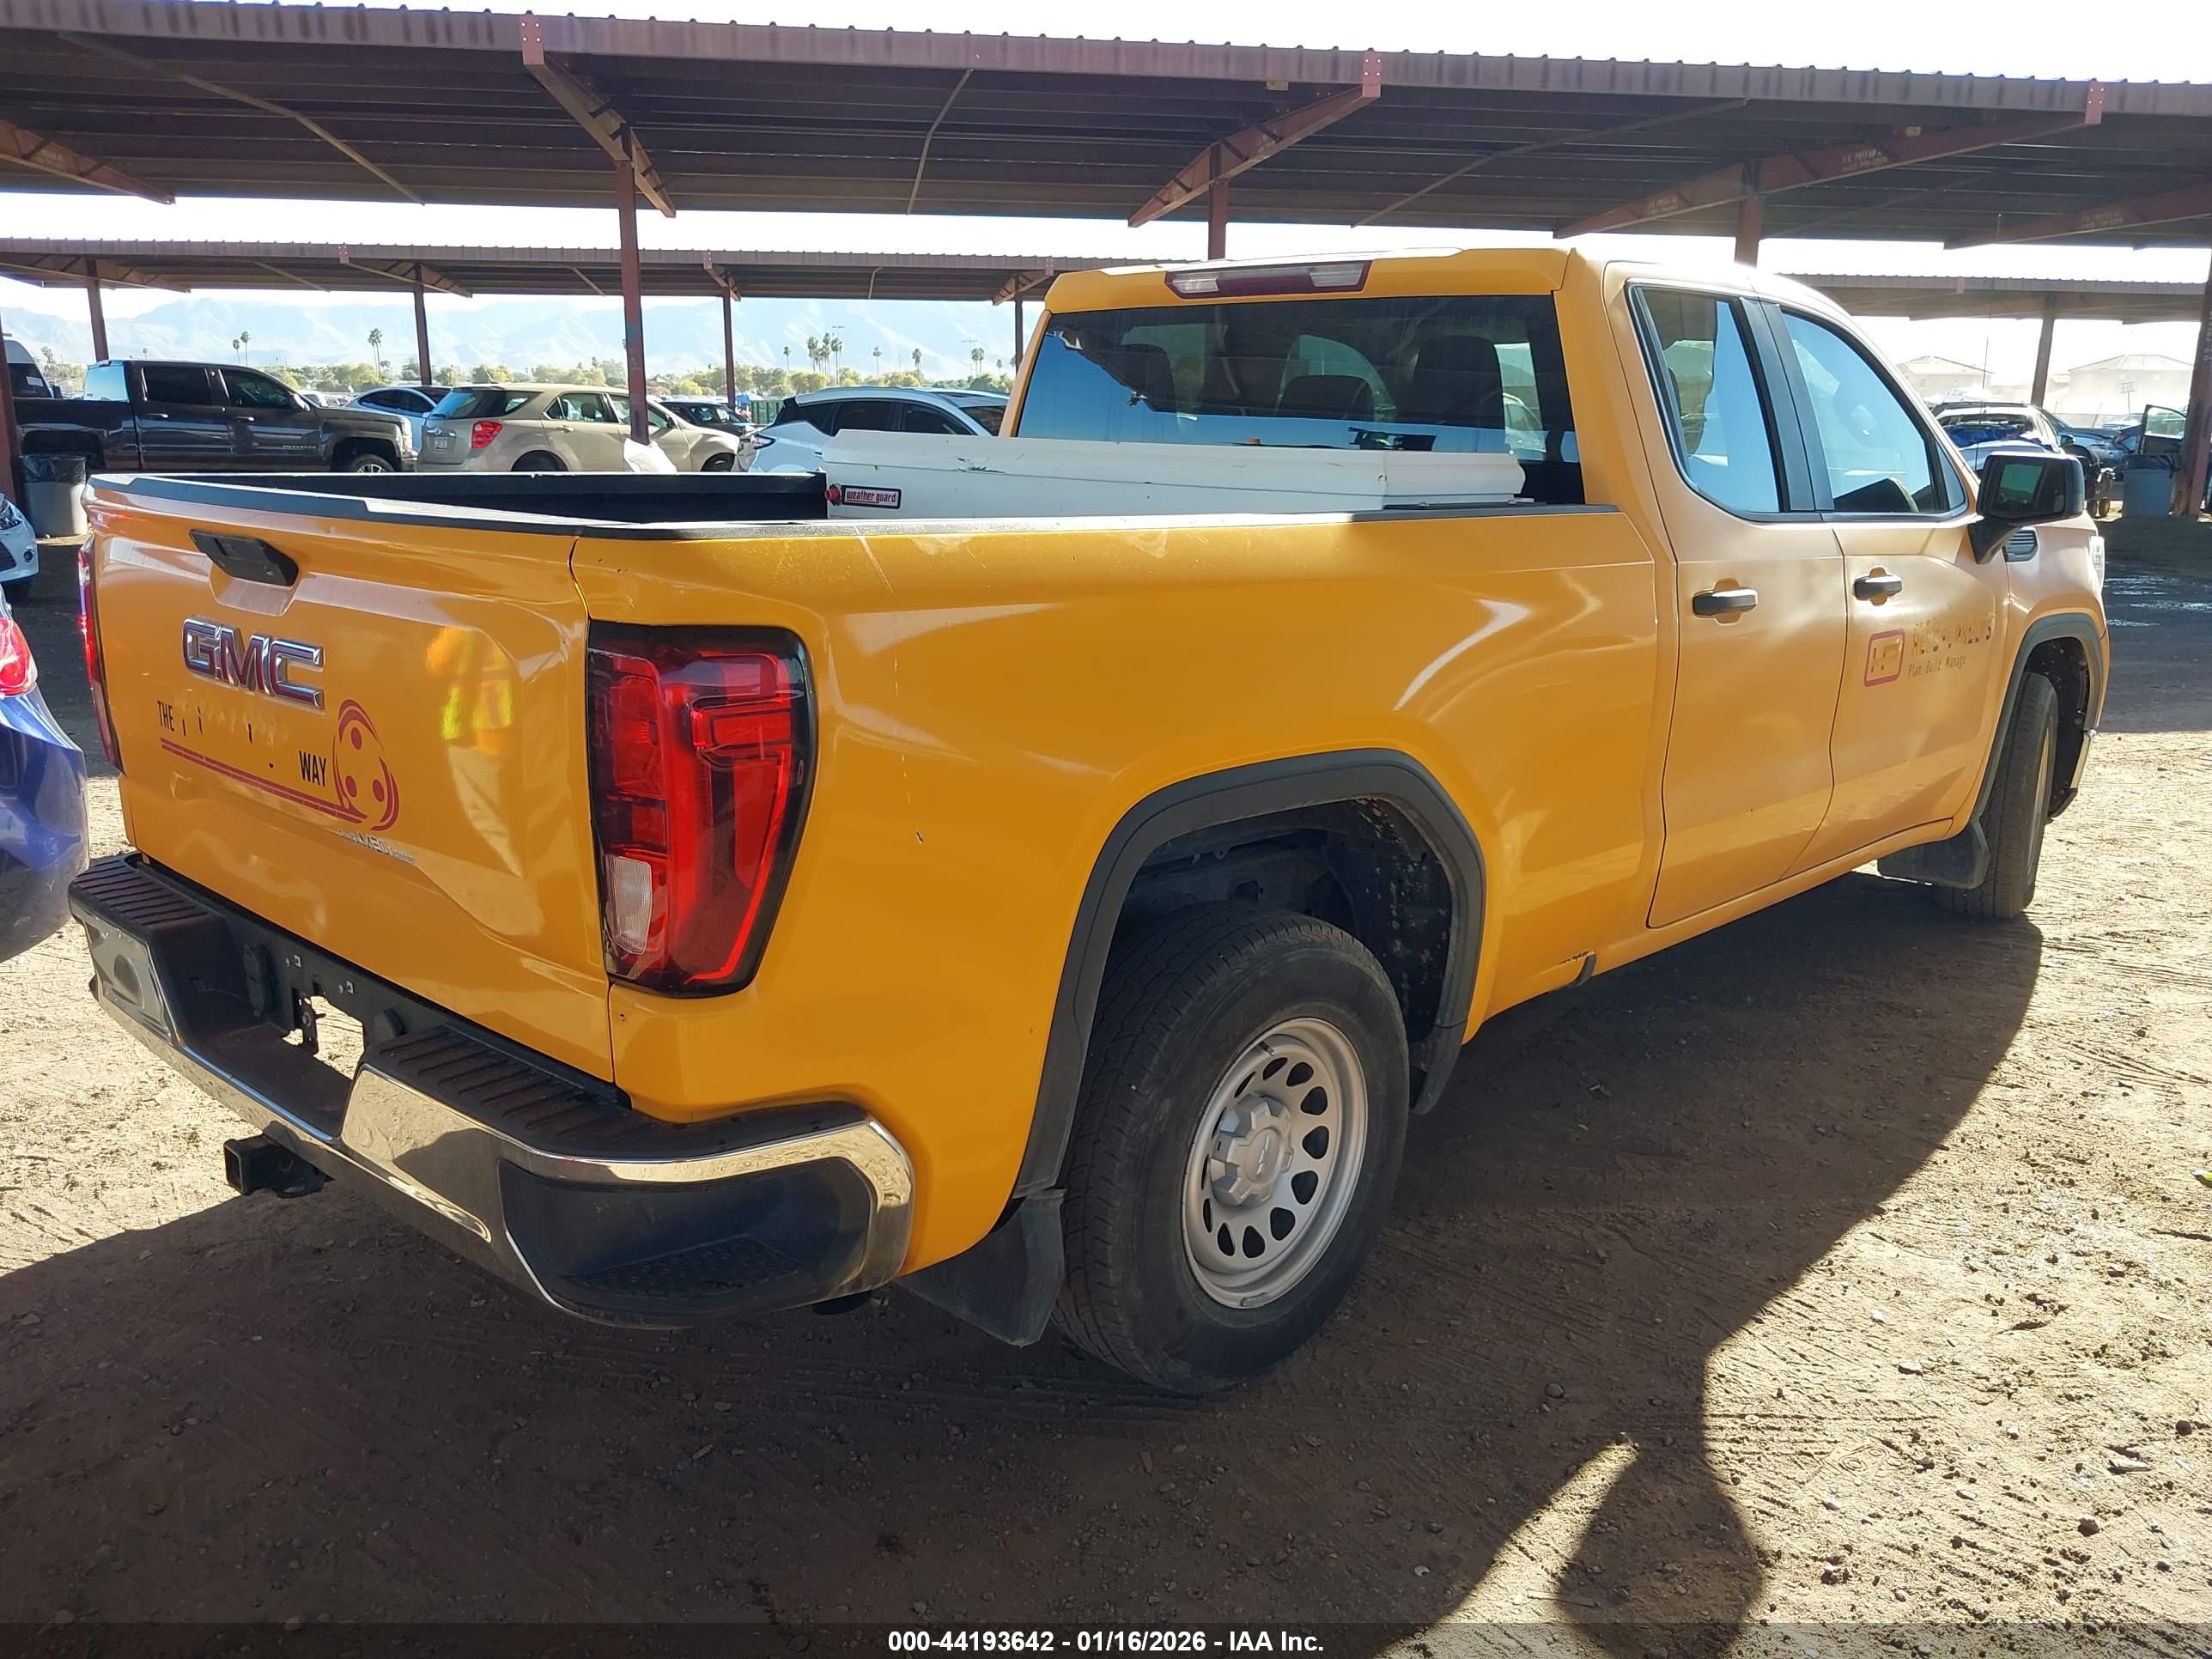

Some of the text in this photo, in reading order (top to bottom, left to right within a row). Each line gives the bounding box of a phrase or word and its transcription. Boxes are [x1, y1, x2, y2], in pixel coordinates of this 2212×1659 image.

[846, 490, 897, 503] weather guard
[182, 617, 325, 709] GMC
[157, 701, 326, 787] THE WAY
